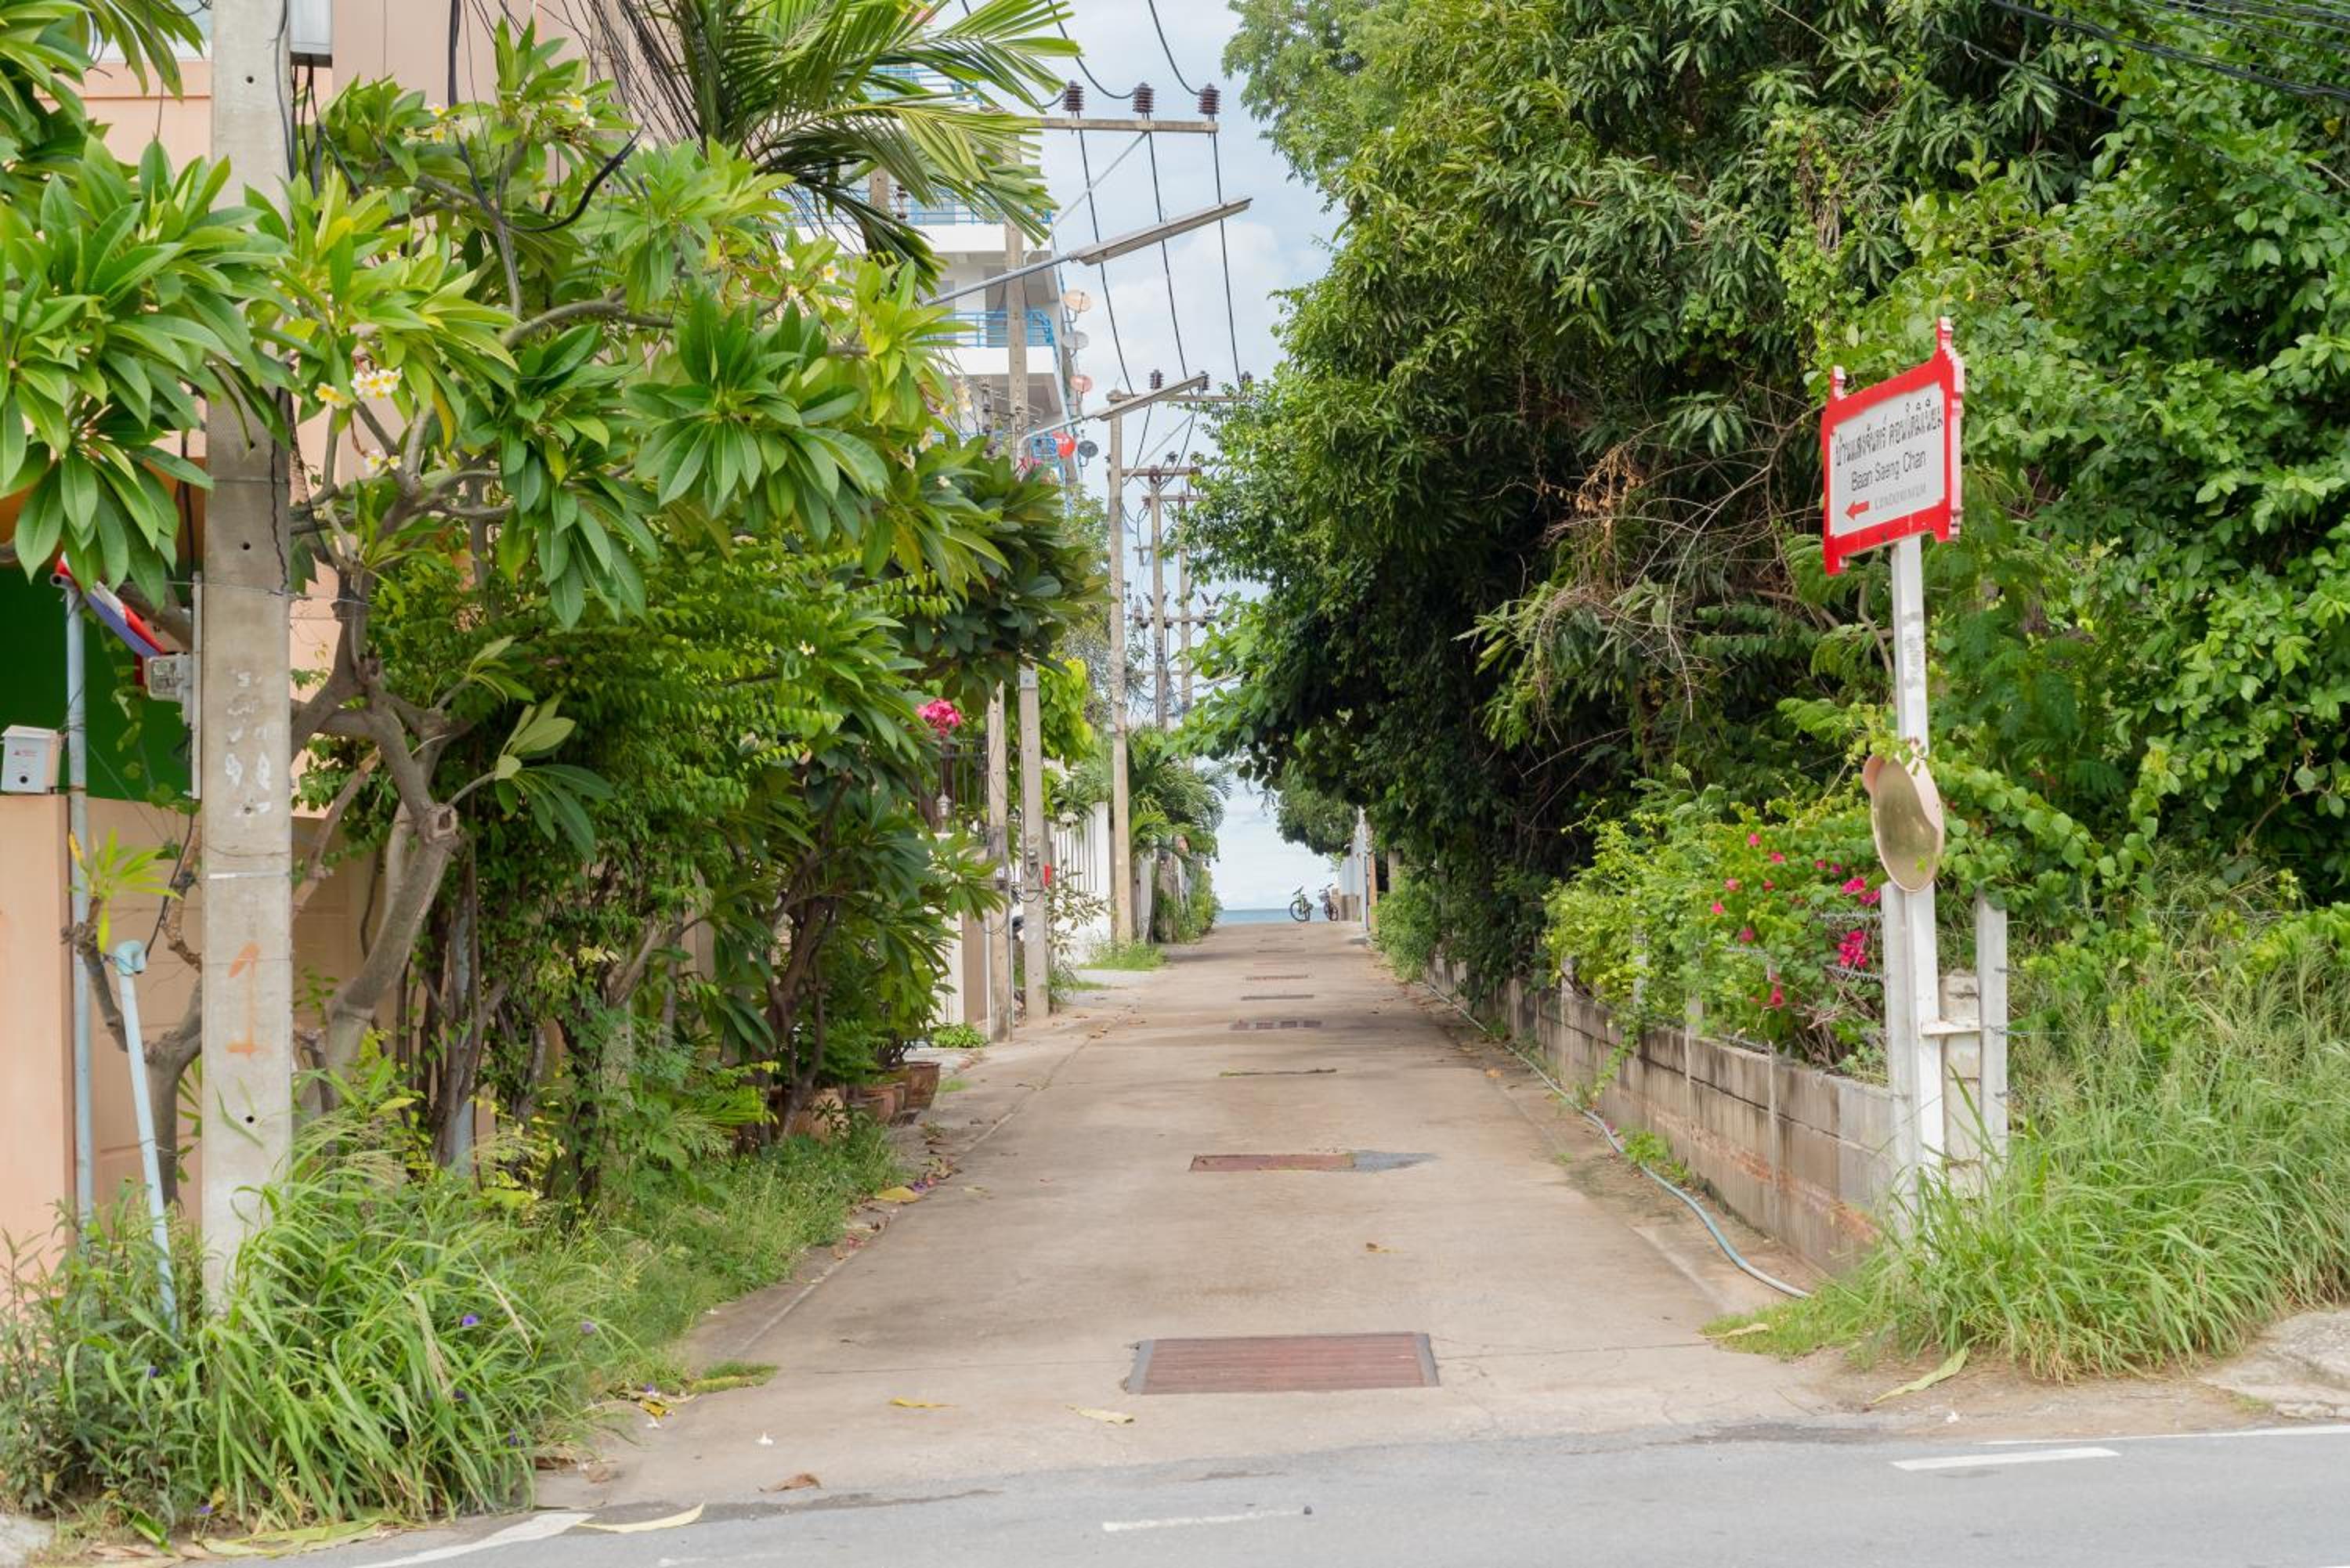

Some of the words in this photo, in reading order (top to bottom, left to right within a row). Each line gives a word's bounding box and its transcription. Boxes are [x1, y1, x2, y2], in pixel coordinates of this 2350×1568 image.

[1852, 470, 1872, 491] Baan
[1875, 461, 1899, 481] Saeng
[1904, 450, 1927, 472] Chan
